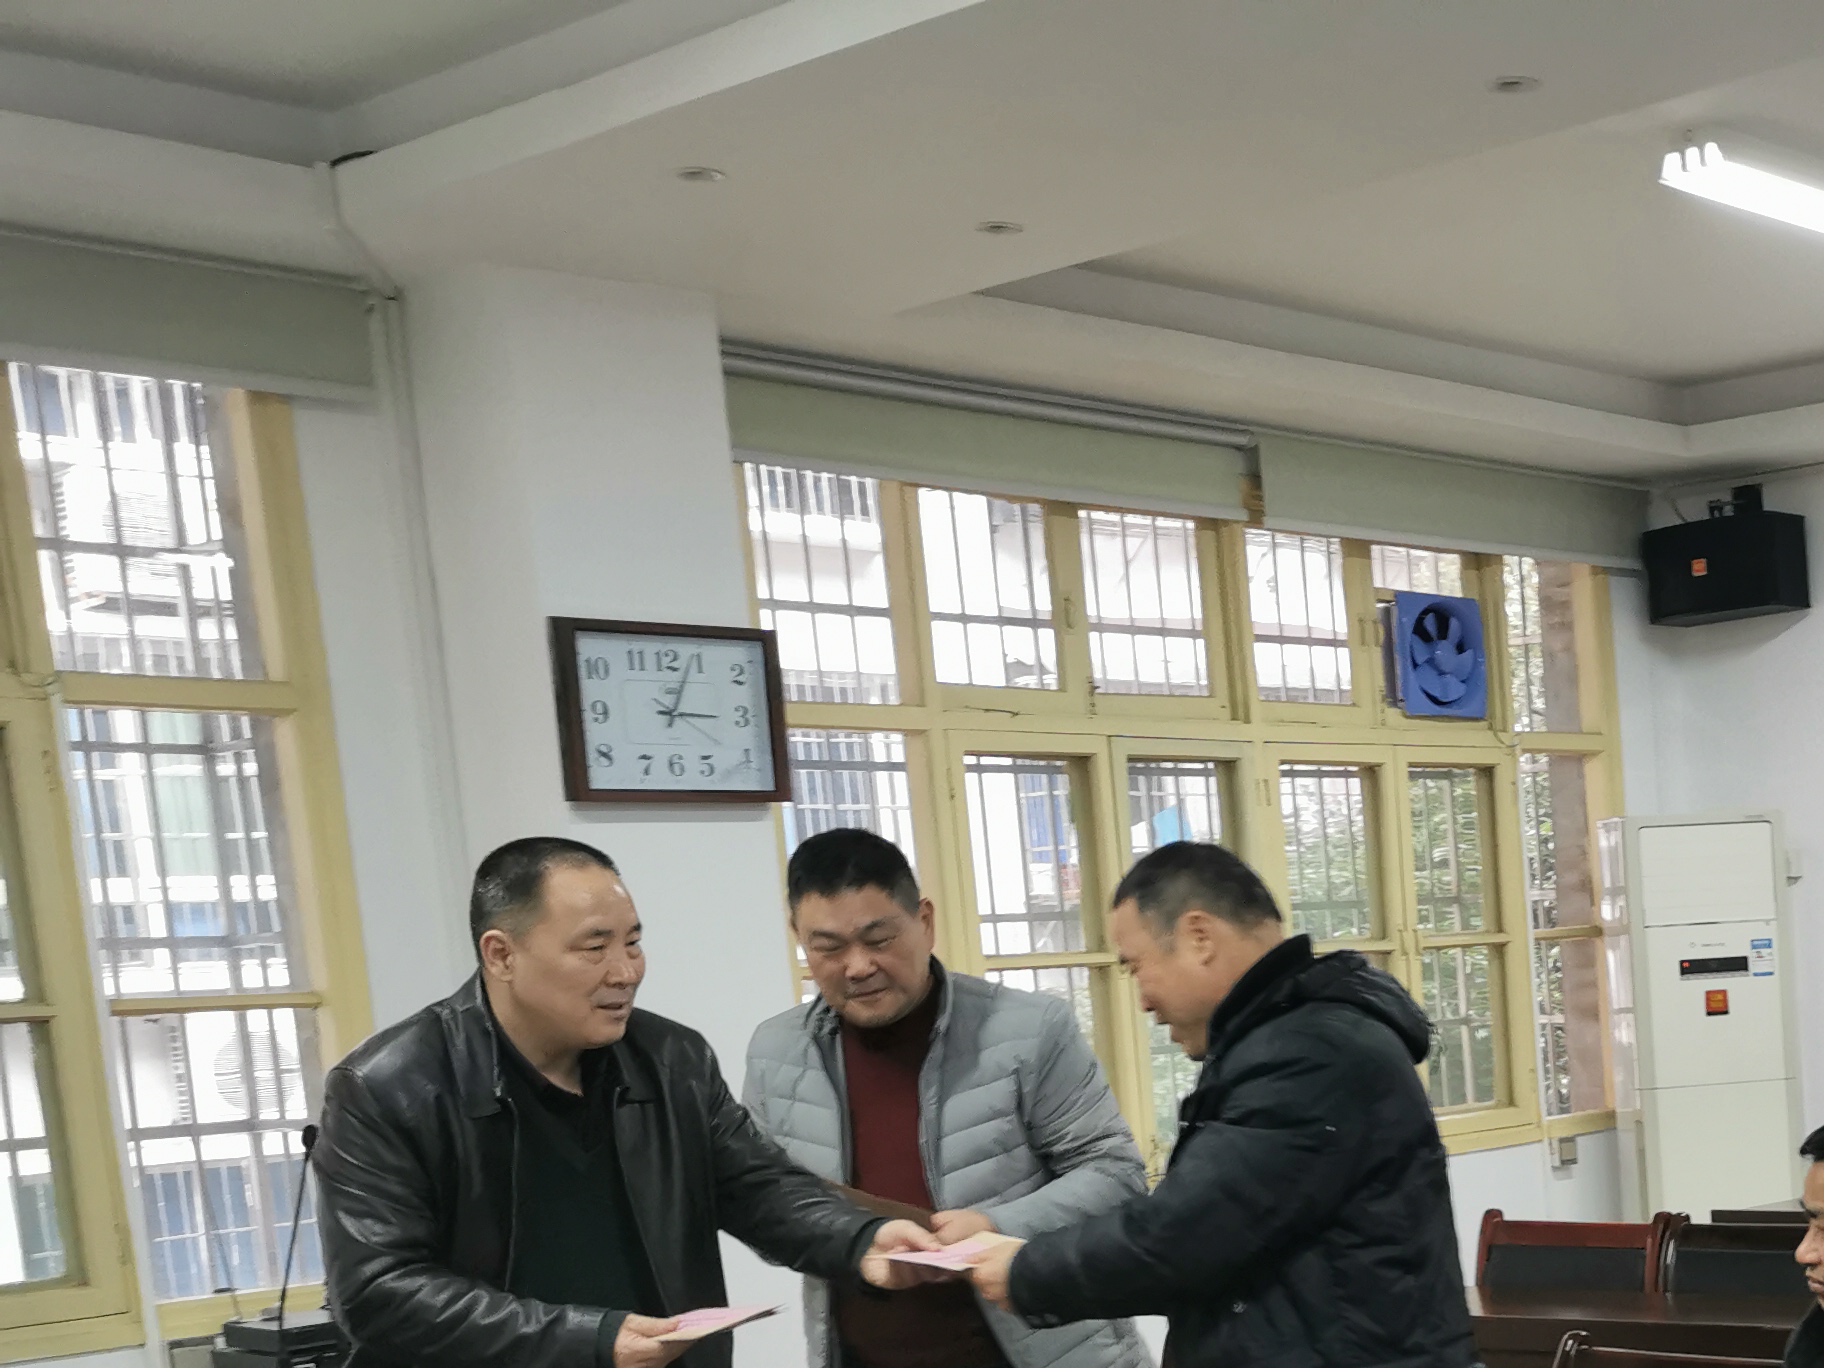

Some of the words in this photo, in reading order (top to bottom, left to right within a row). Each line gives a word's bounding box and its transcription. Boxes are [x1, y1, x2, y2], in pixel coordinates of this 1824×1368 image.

[584, 656, 610, 680] 10
[626, 648, 647, 672] 11
[654, 648, 680, 672] 12
[730, 663, 747, 686] 2
[590, 700, 610, 724] 9
[734, 705, 750, 728] 3
[595, 743, 614, 767] 8
[638, 753, 654, 776] 7
[667, 753, 685, 776] 6
[700, 754, 715, 777] 5
